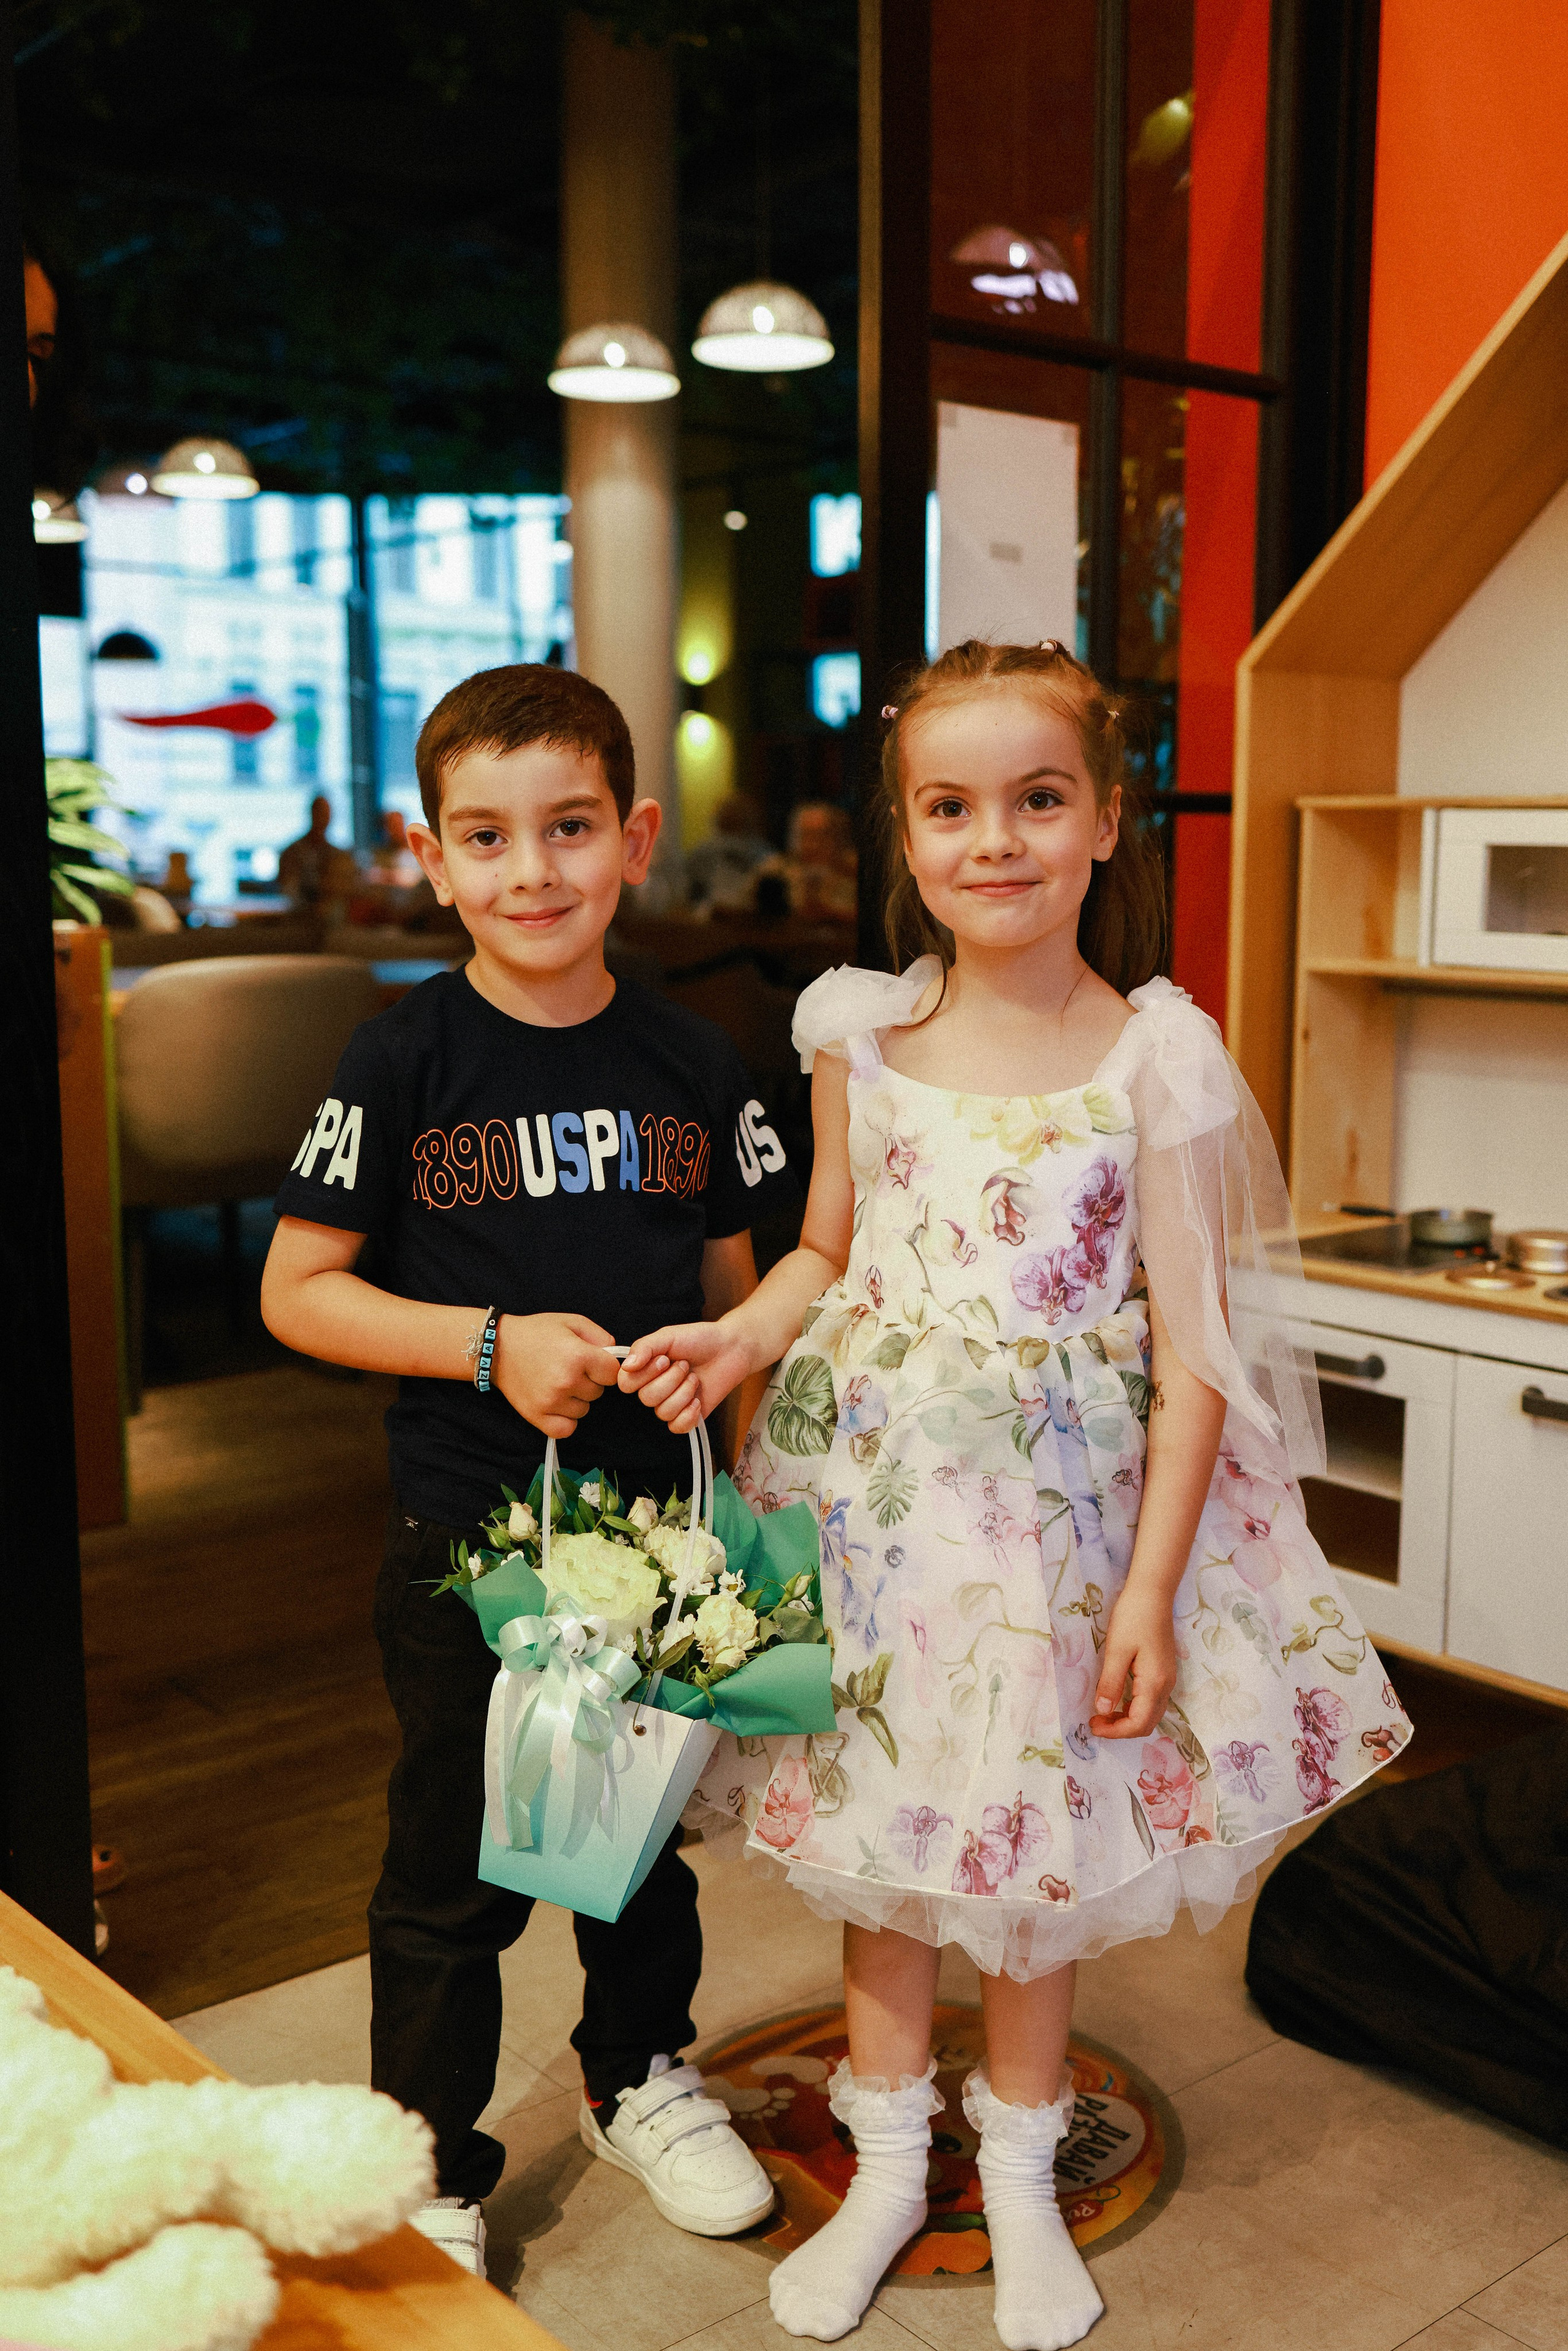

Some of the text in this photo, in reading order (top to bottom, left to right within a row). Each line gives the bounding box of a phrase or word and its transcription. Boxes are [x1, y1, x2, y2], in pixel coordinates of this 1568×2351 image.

[290, 1098, 363, 1190] PA
[736, 1099, 786, 1187] US
[1052, 2119, 1132, 2185] ДАВАЙ
